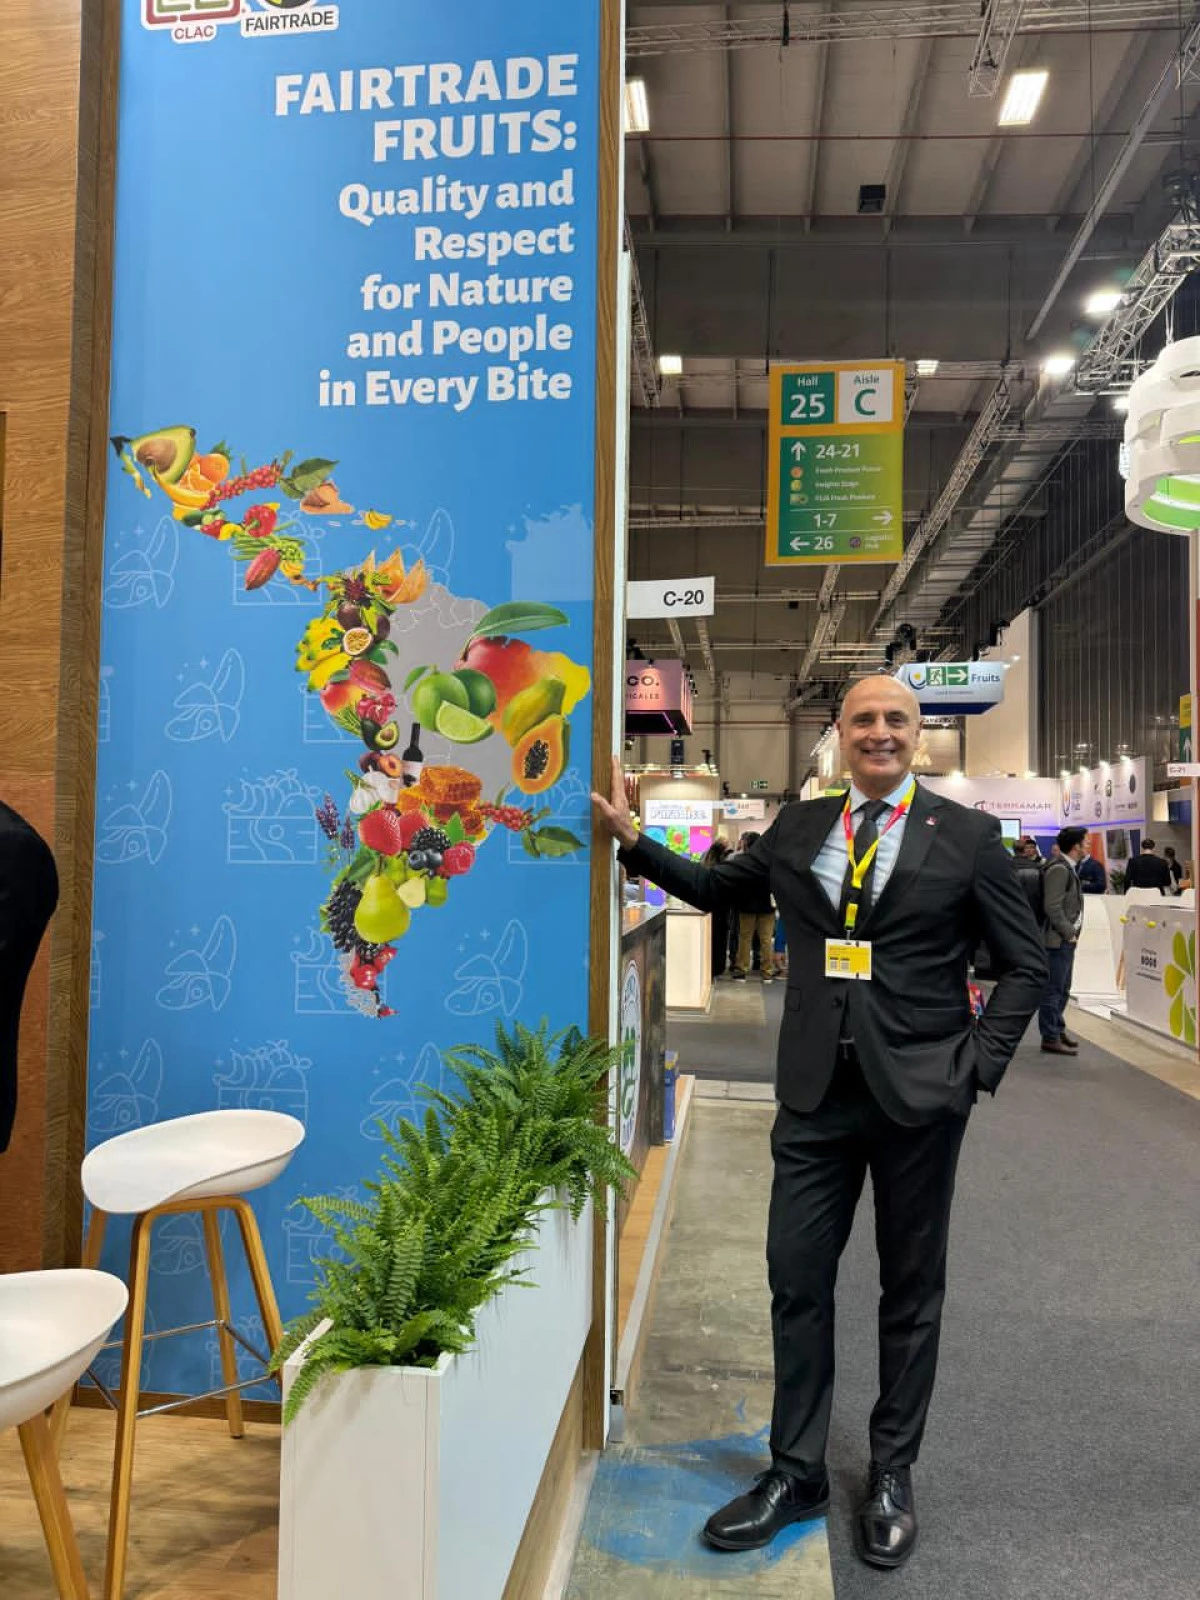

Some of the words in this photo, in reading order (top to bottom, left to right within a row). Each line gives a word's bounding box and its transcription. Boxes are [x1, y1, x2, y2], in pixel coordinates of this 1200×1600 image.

[174, 25, 215, 40] CLAC
[245, 10, 335, 32] FAIRTRADE
[275, 54, 578, 115] FAIRTRADE
[373, 110, 577, 162] FRUITS:
[339, 174, 488, 225] Quality
[495, 169, 574, 209] and
[414, 223, 575, 265] Respect
[361, 274, 420, 311] for
[428, 272, 573, 307] Nature
[347, 319, 422, 359] and
[433, 314, 572, 361] People
[319, 370, 356, 407] in
[366, 370, 477, 412] Every
[487, 363, 571, 401] Bite
[797, 375, 819, 387] Hall
[853, 375, 880, 385] Aisle
[790, 393, 825, 419] 25
[854, 389, 876, 415] C
[815, 444, 860, 460] 24-21
[813, 513, 837, 528] 1-7
[813, 535, 834, 550] 26
[663, 589, 705, 607] C-20
[971, 673, 1001, 683] Fruits
